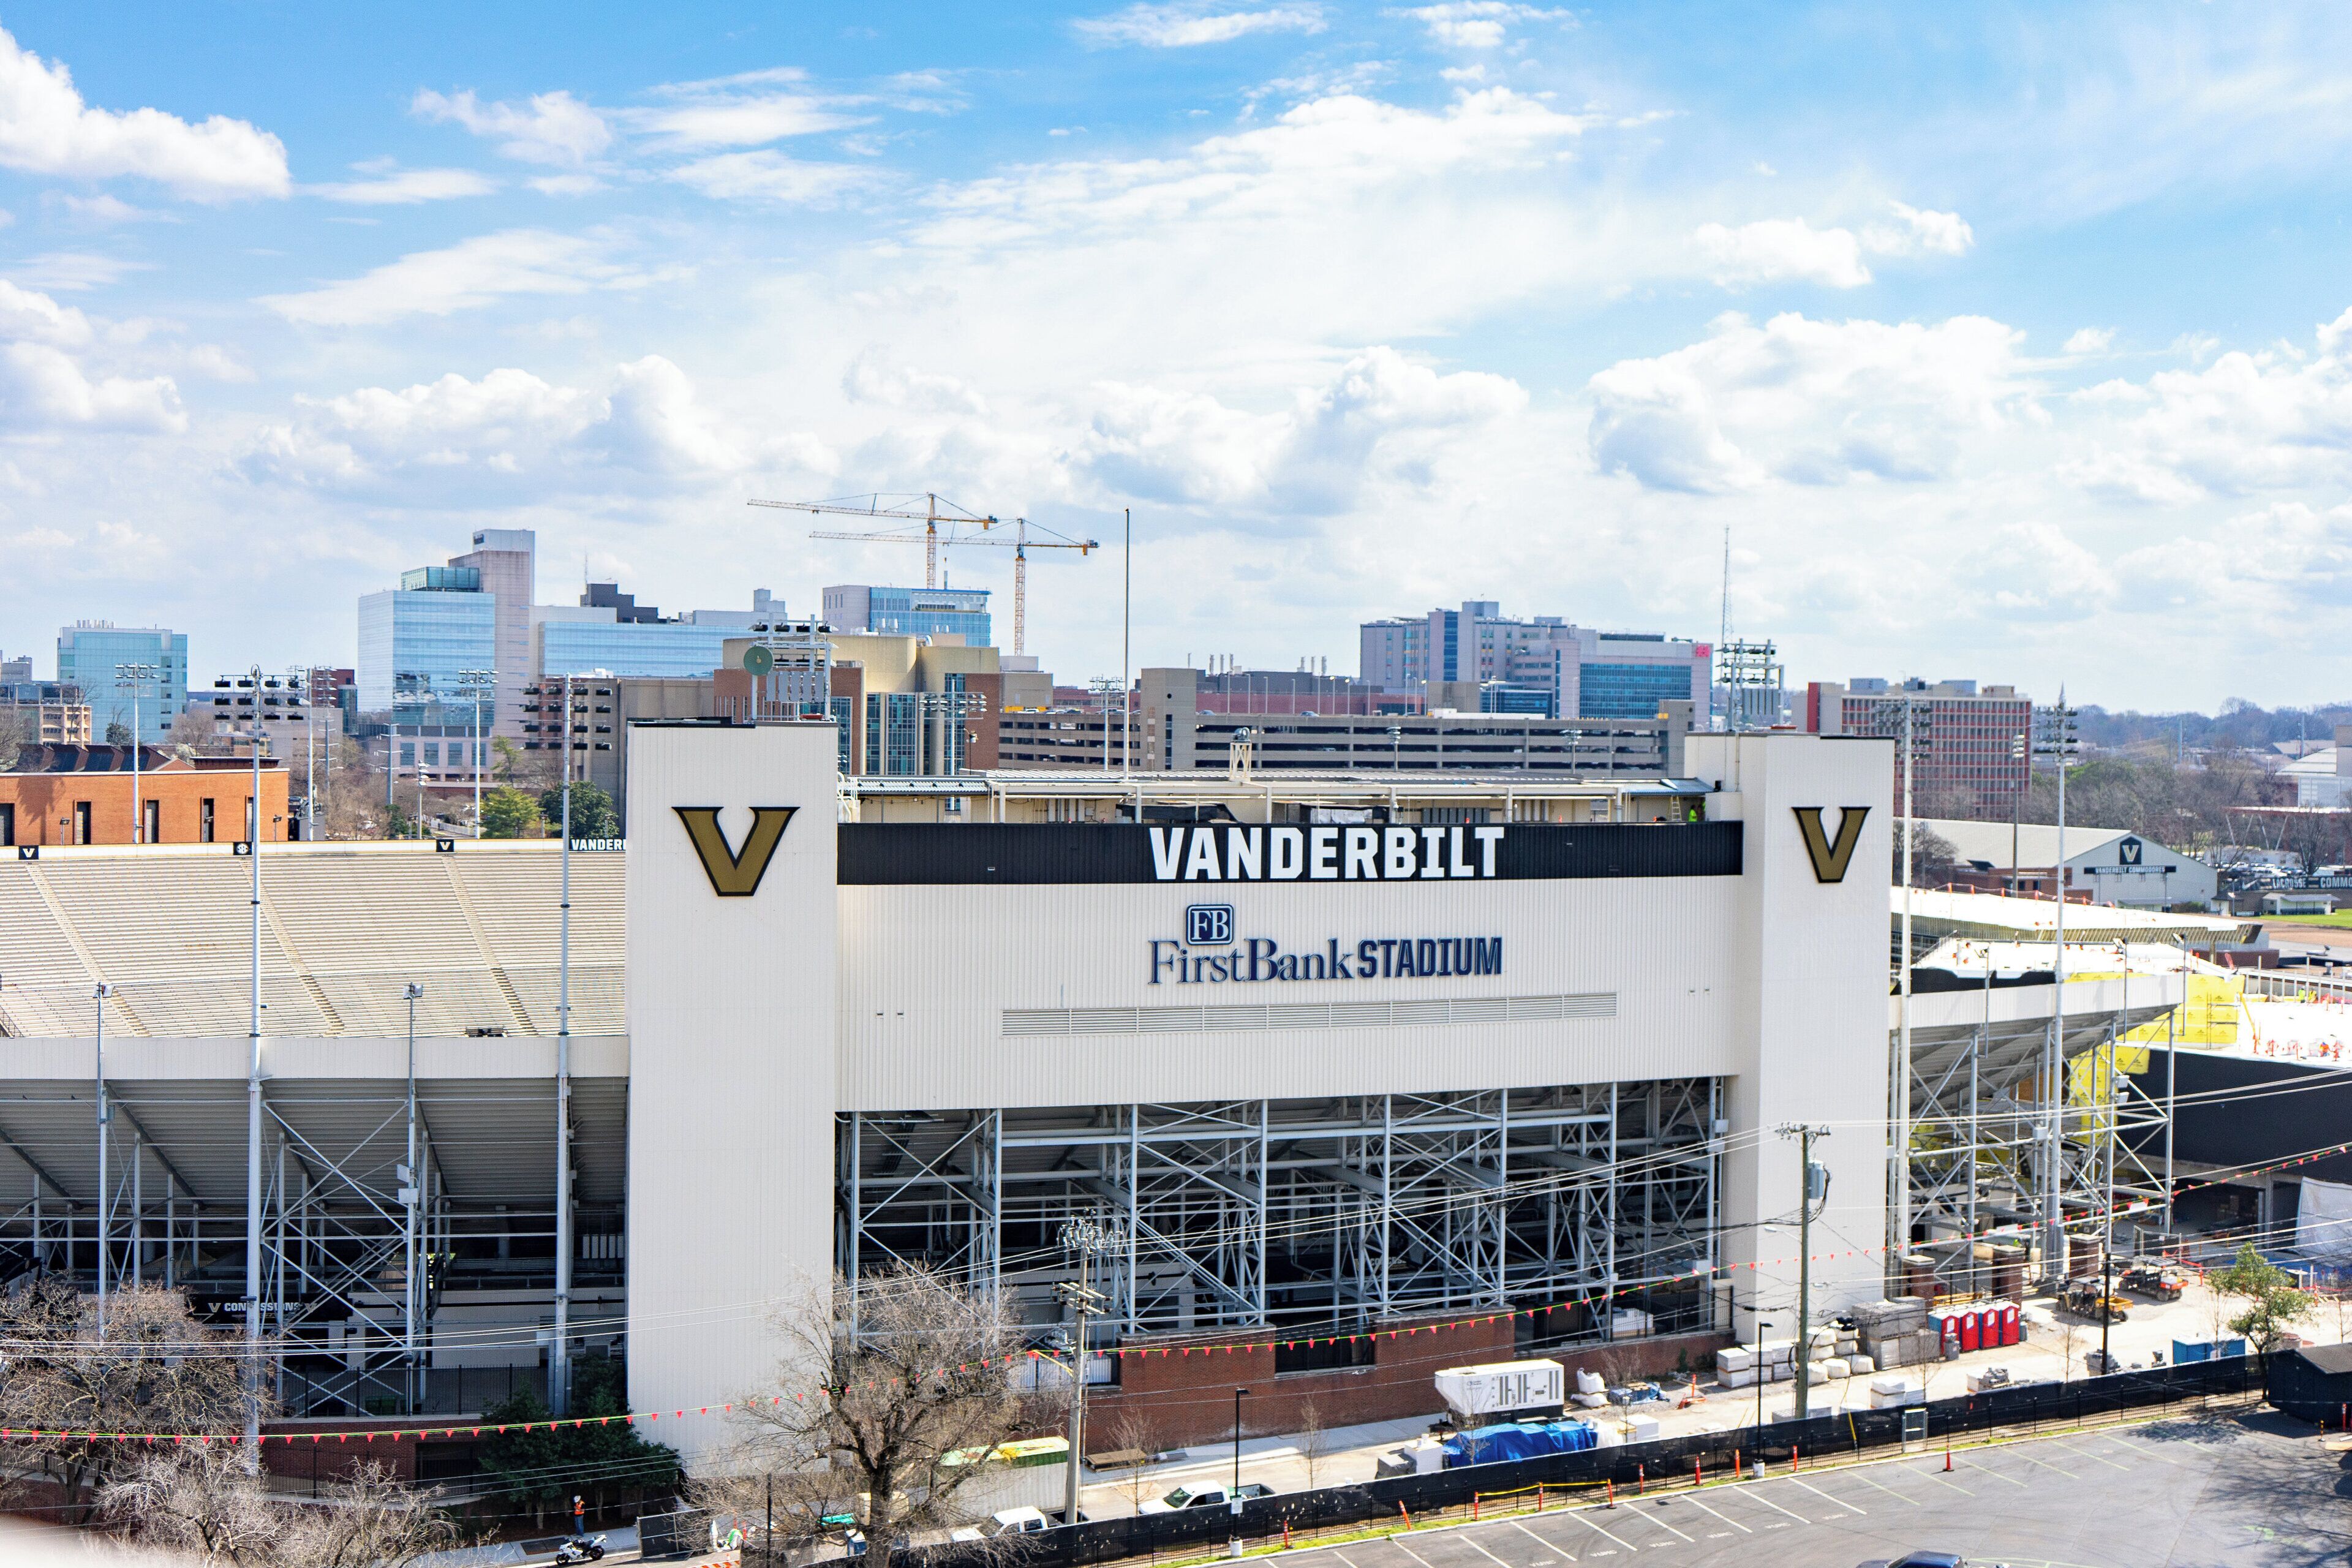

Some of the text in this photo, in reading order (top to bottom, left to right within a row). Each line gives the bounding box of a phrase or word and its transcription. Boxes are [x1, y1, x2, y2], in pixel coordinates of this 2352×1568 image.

[23, 848, 35, 858] V
[672, 807, 801, 897] V
[1149, 826, 1505, 881] VANDERBILT
[1792, 806, 1872, 883] V
[2122, 845, 2139, 863] V
[2272, 877, 2307, 889] LACROSSE
[1191, 910, 1230, 940] FB
[1358, 936, 1503, 979] STADIUM
